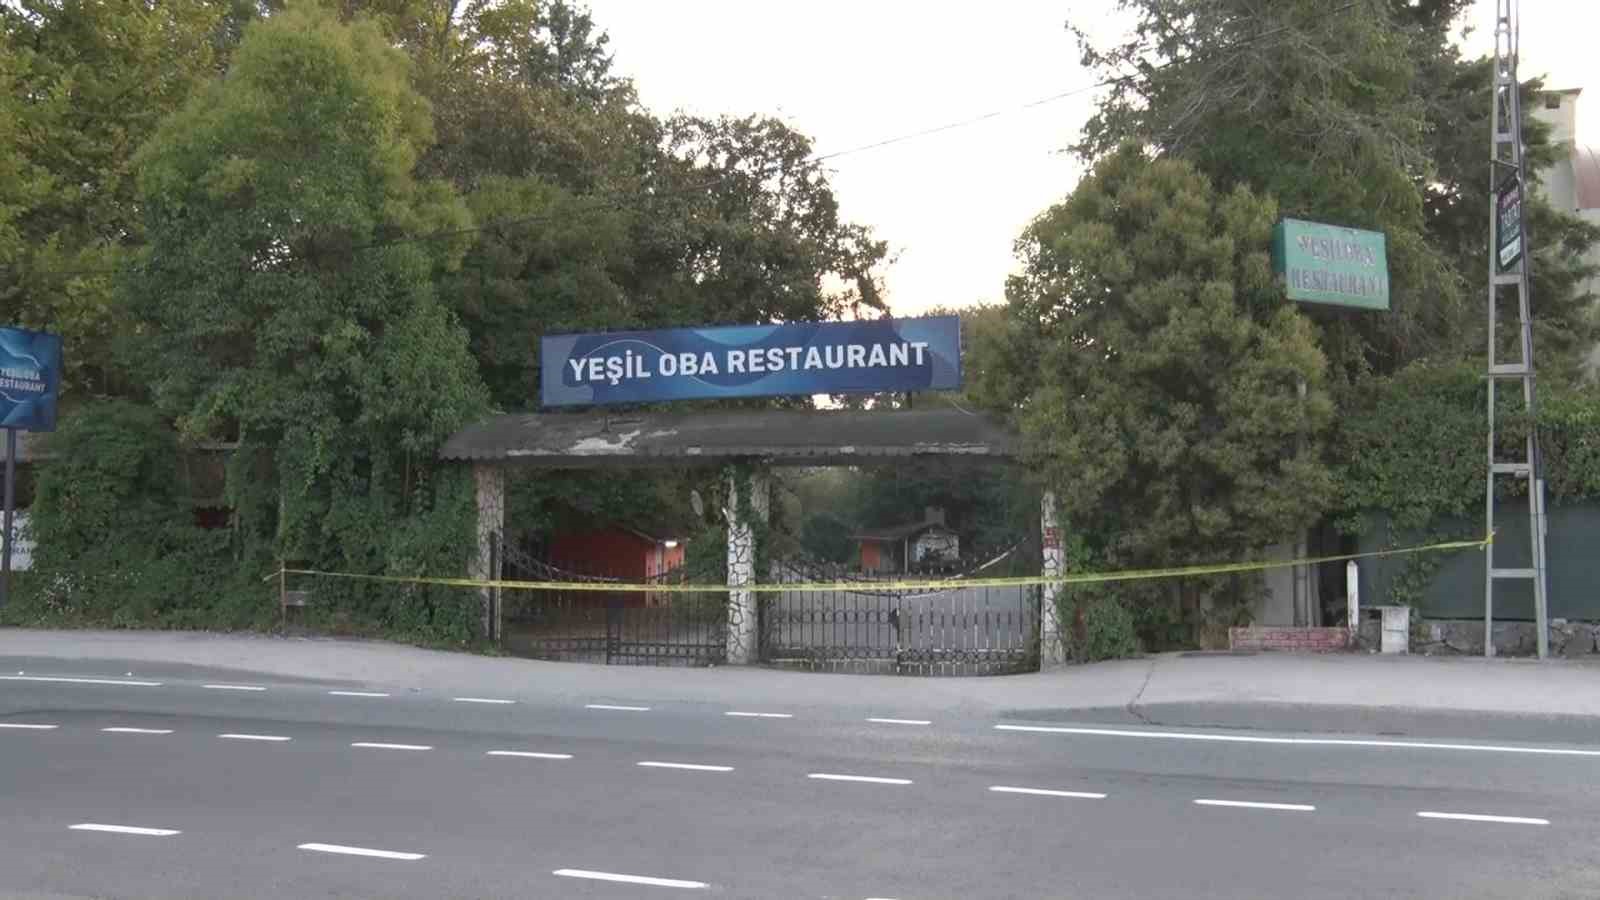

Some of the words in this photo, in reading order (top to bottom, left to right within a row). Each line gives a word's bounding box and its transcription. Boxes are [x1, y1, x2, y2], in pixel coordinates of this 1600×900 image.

[569, 350, 650, 385] YEŞİL
[659, 352, 718, 376] OBA
[727, 342, 928, 373] RESTAURANT
